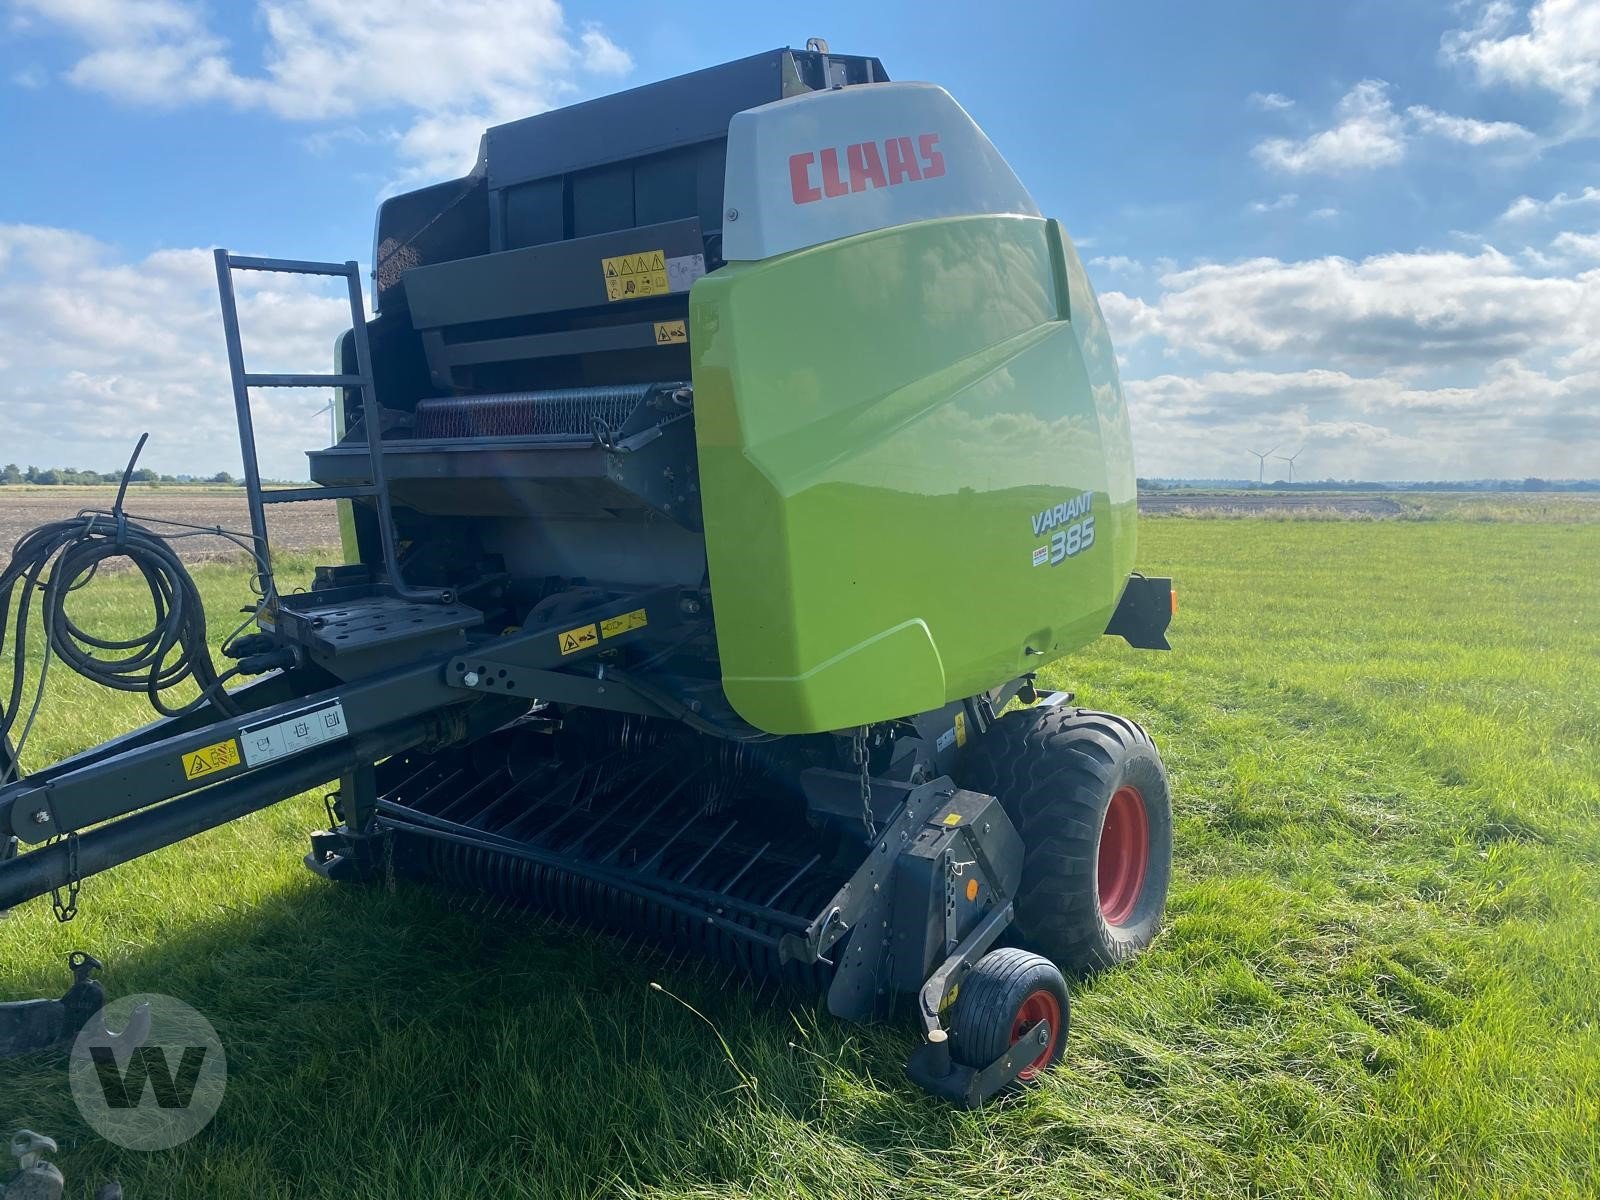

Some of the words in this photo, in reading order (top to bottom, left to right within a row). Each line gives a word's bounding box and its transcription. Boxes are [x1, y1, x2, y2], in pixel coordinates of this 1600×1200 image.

[789, 133, 945, 205] CLAAS
[1031, 489, 1094, 536] VARIANT
[1050, 516, 1095, 566] 385
